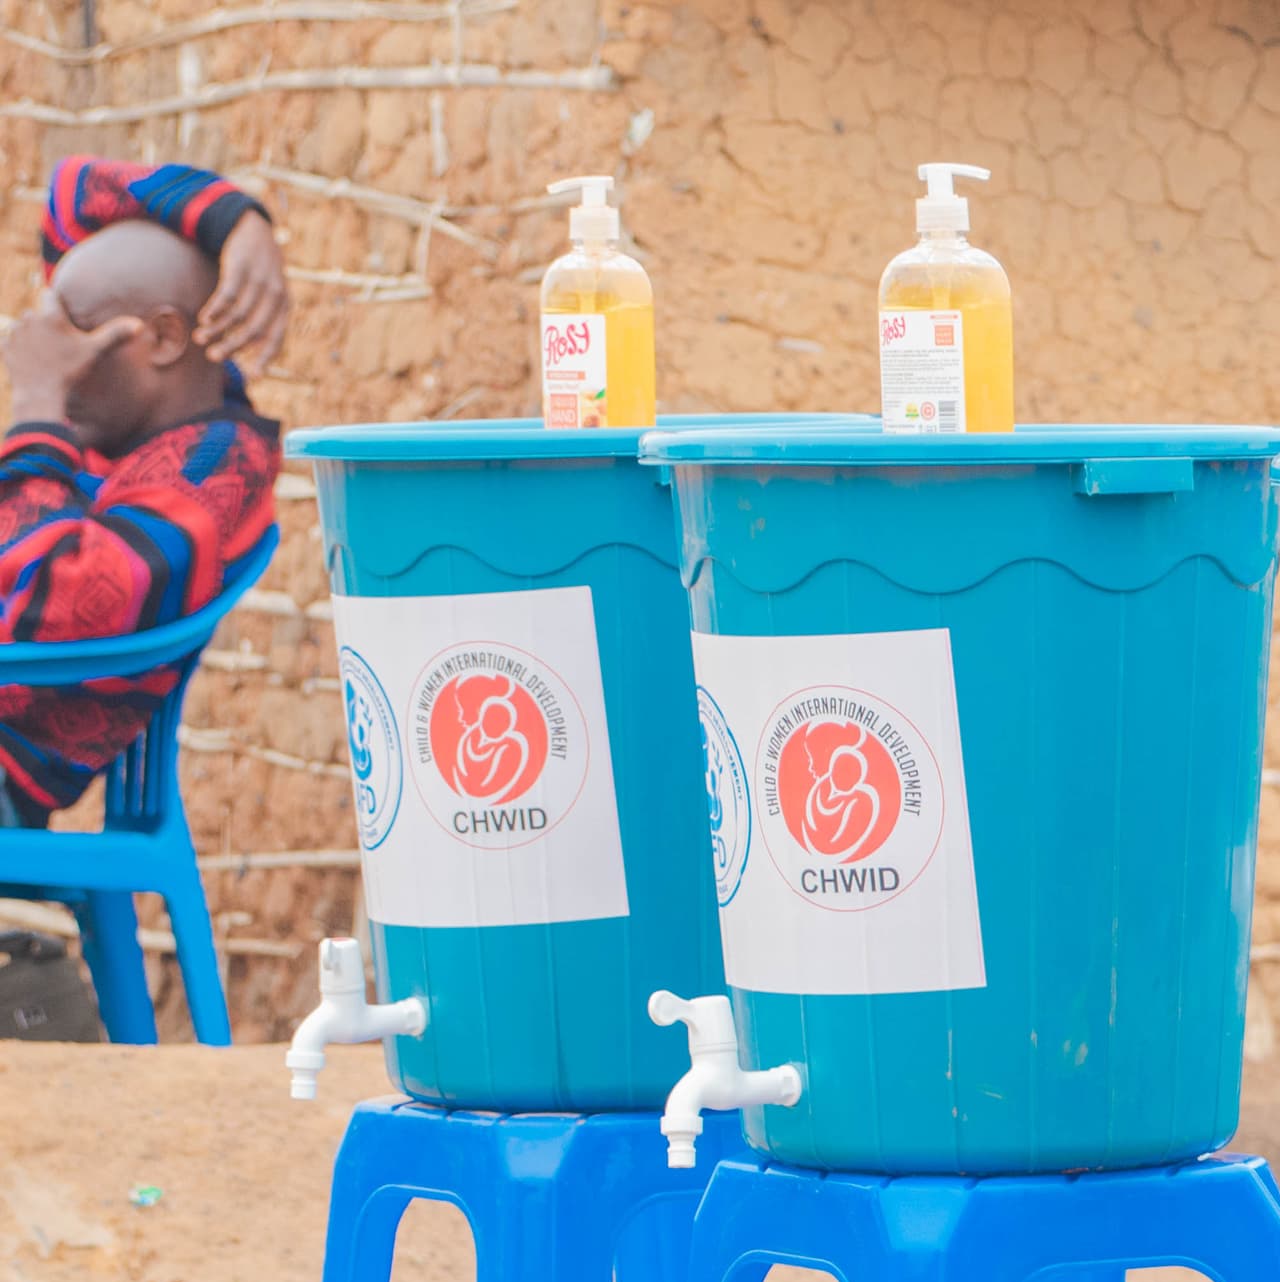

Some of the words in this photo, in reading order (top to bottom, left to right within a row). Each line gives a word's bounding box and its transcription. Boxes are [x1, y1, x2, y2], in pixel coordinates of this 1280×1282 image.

[441, 652, 528, 682] INTERNATIONAL
[418, 669, 446, 712] WOMEN
[526, 674, 568, 760] DEVELOPMENT
[790, 697, 879, 731] INTERNATIONAL
[416, 726, 432, 764] CHILD
[767, 714, 794, 760] WOMEN
[878, 723, 922, 816] DEVELOPMENT
[764, 776, 780, 816] CHILD
[453, 808, 547, 834] CHWID
[801, 867, 900, 894] CHWID
